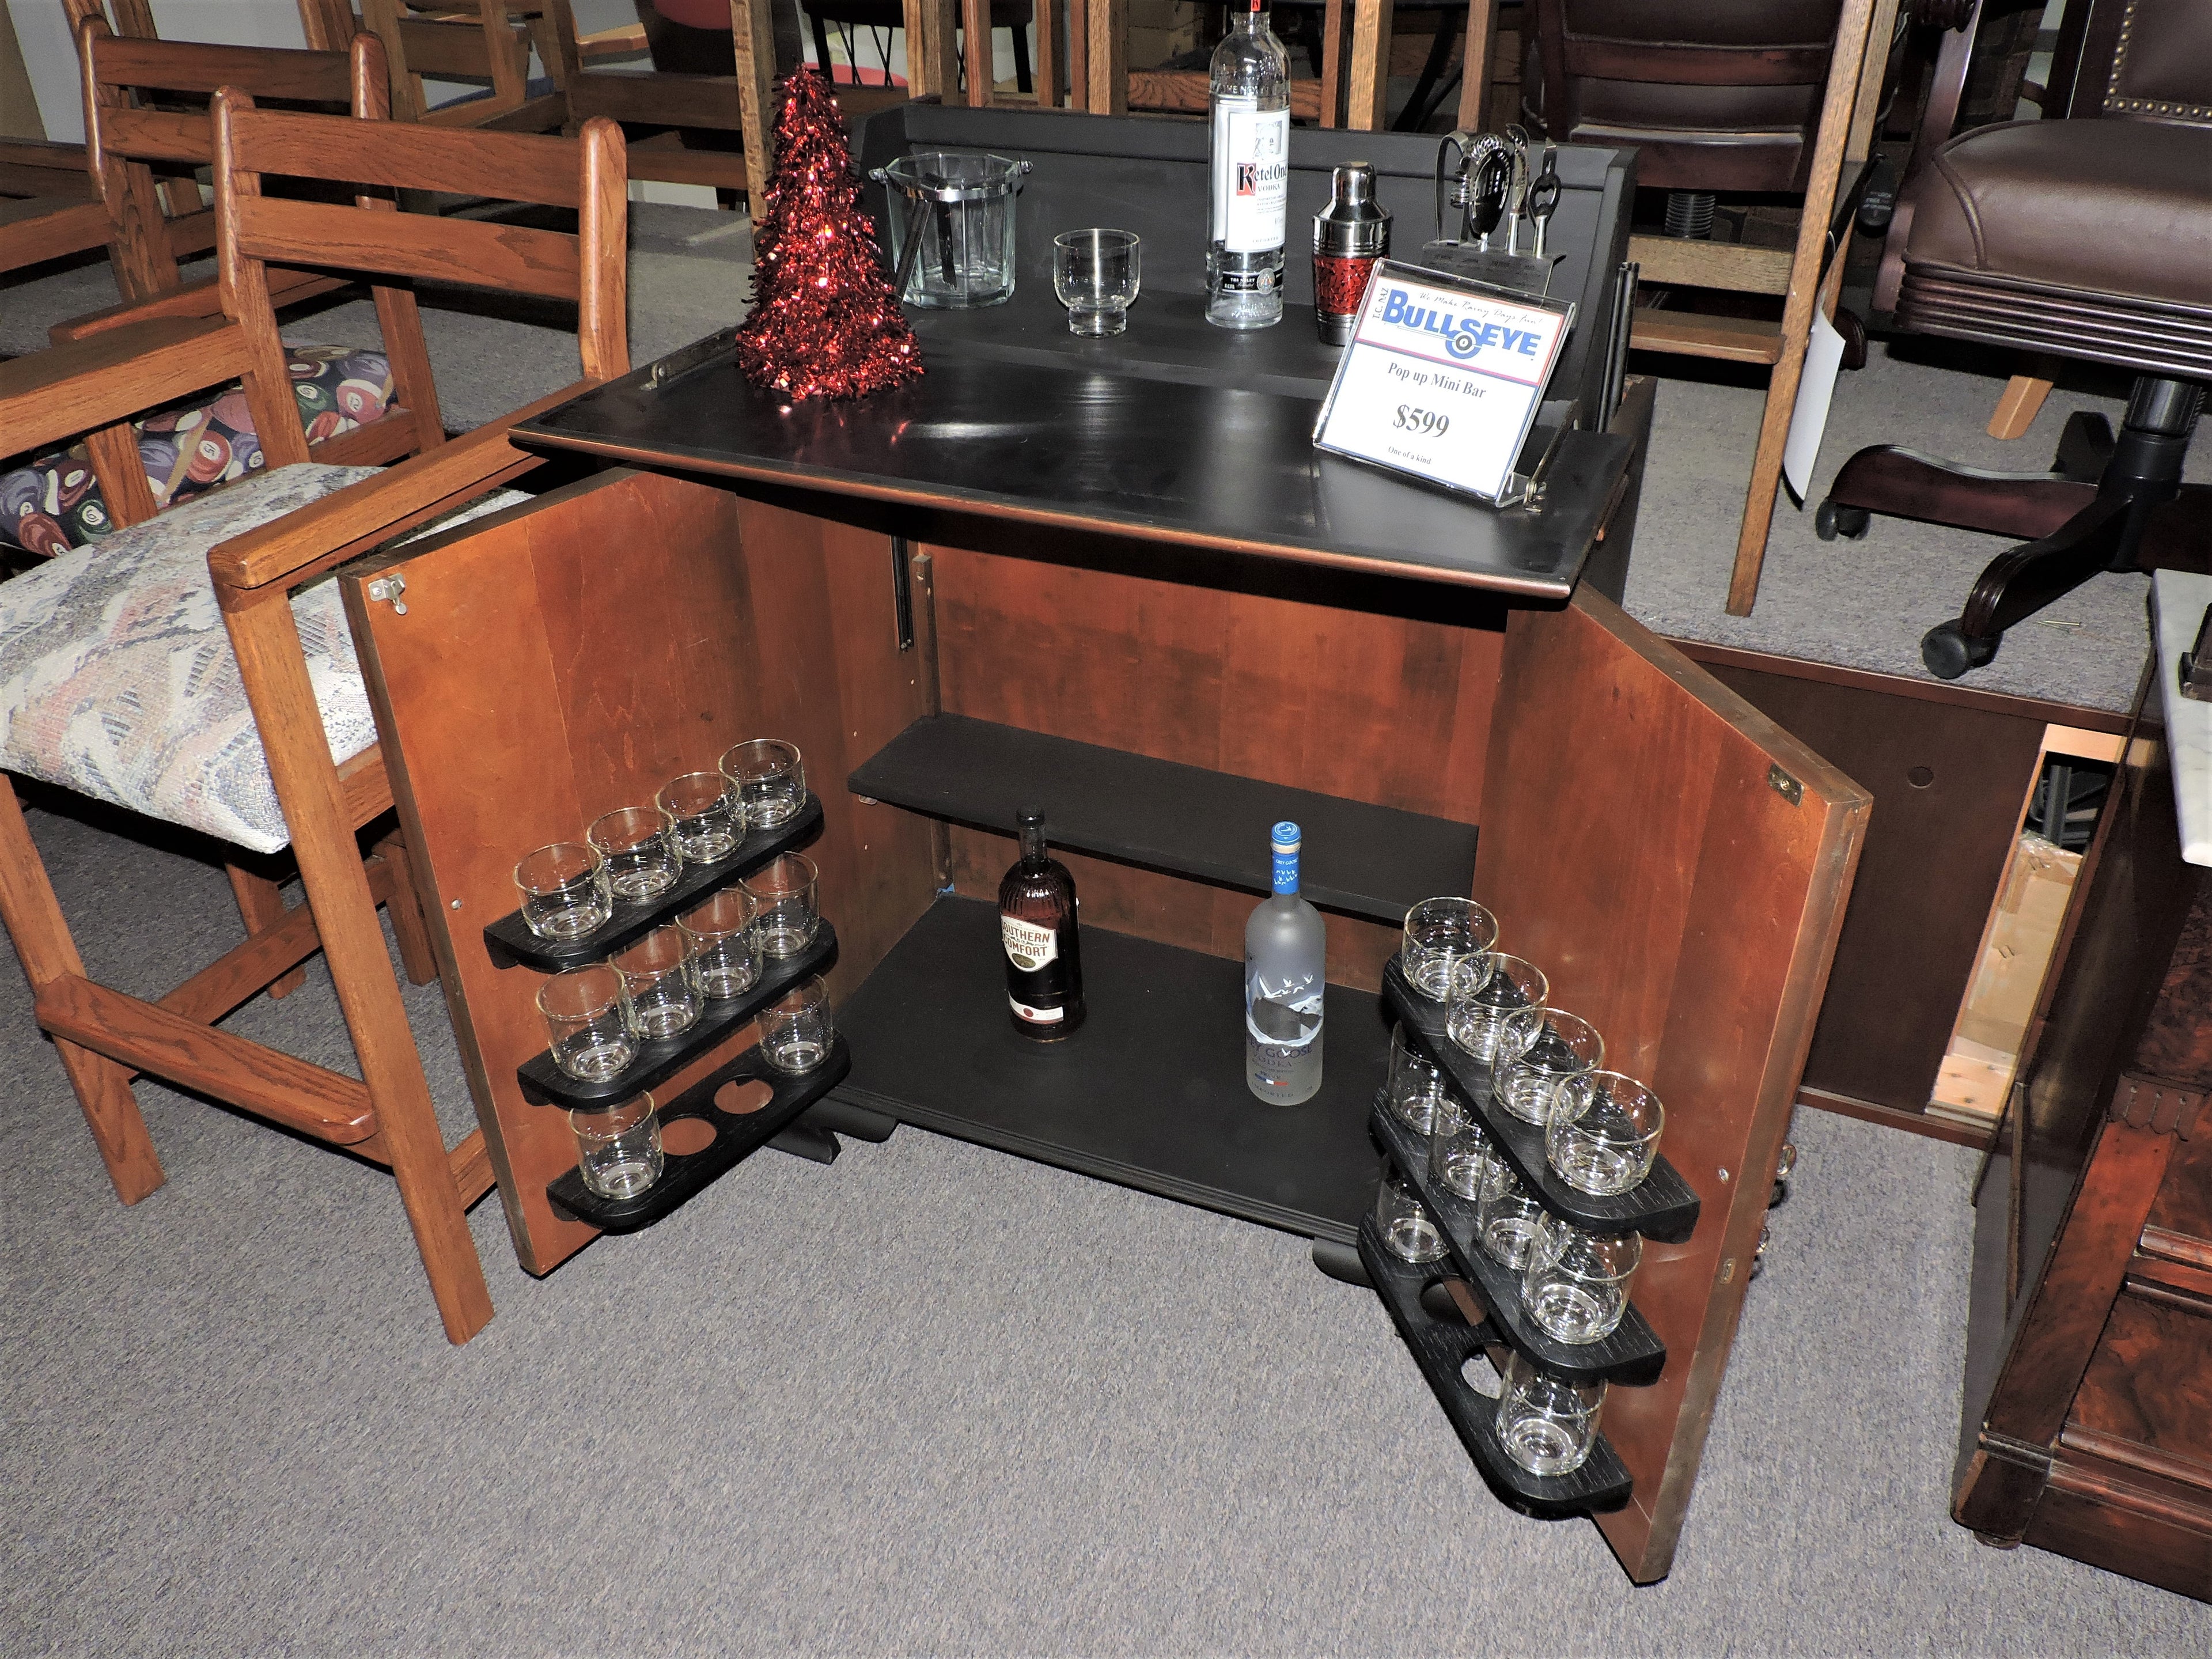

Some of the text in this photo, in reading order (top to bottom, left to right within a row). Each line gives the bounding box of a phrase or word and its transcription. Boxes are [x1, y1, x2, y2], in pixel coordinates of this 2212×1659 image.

[1237, 164, 1272, 194] Ketel
[1257, 183, 1281, 192] VODKA
[1419, 291, 1430, 301] We
[1434, 296, 1457, 307] Make
[1462, 301, 1489, 318] Rainy
[1493, 308, 1516, 323] Days
[1388, 362, 1487, 398] Pop up Mini Bar
[1392, 404, 1450, 438] $599
[1388, 446, 1402, 456] One
[1416, 454, 1432, 465] kind
[1003, 933, 1048, 957] COMFORT
